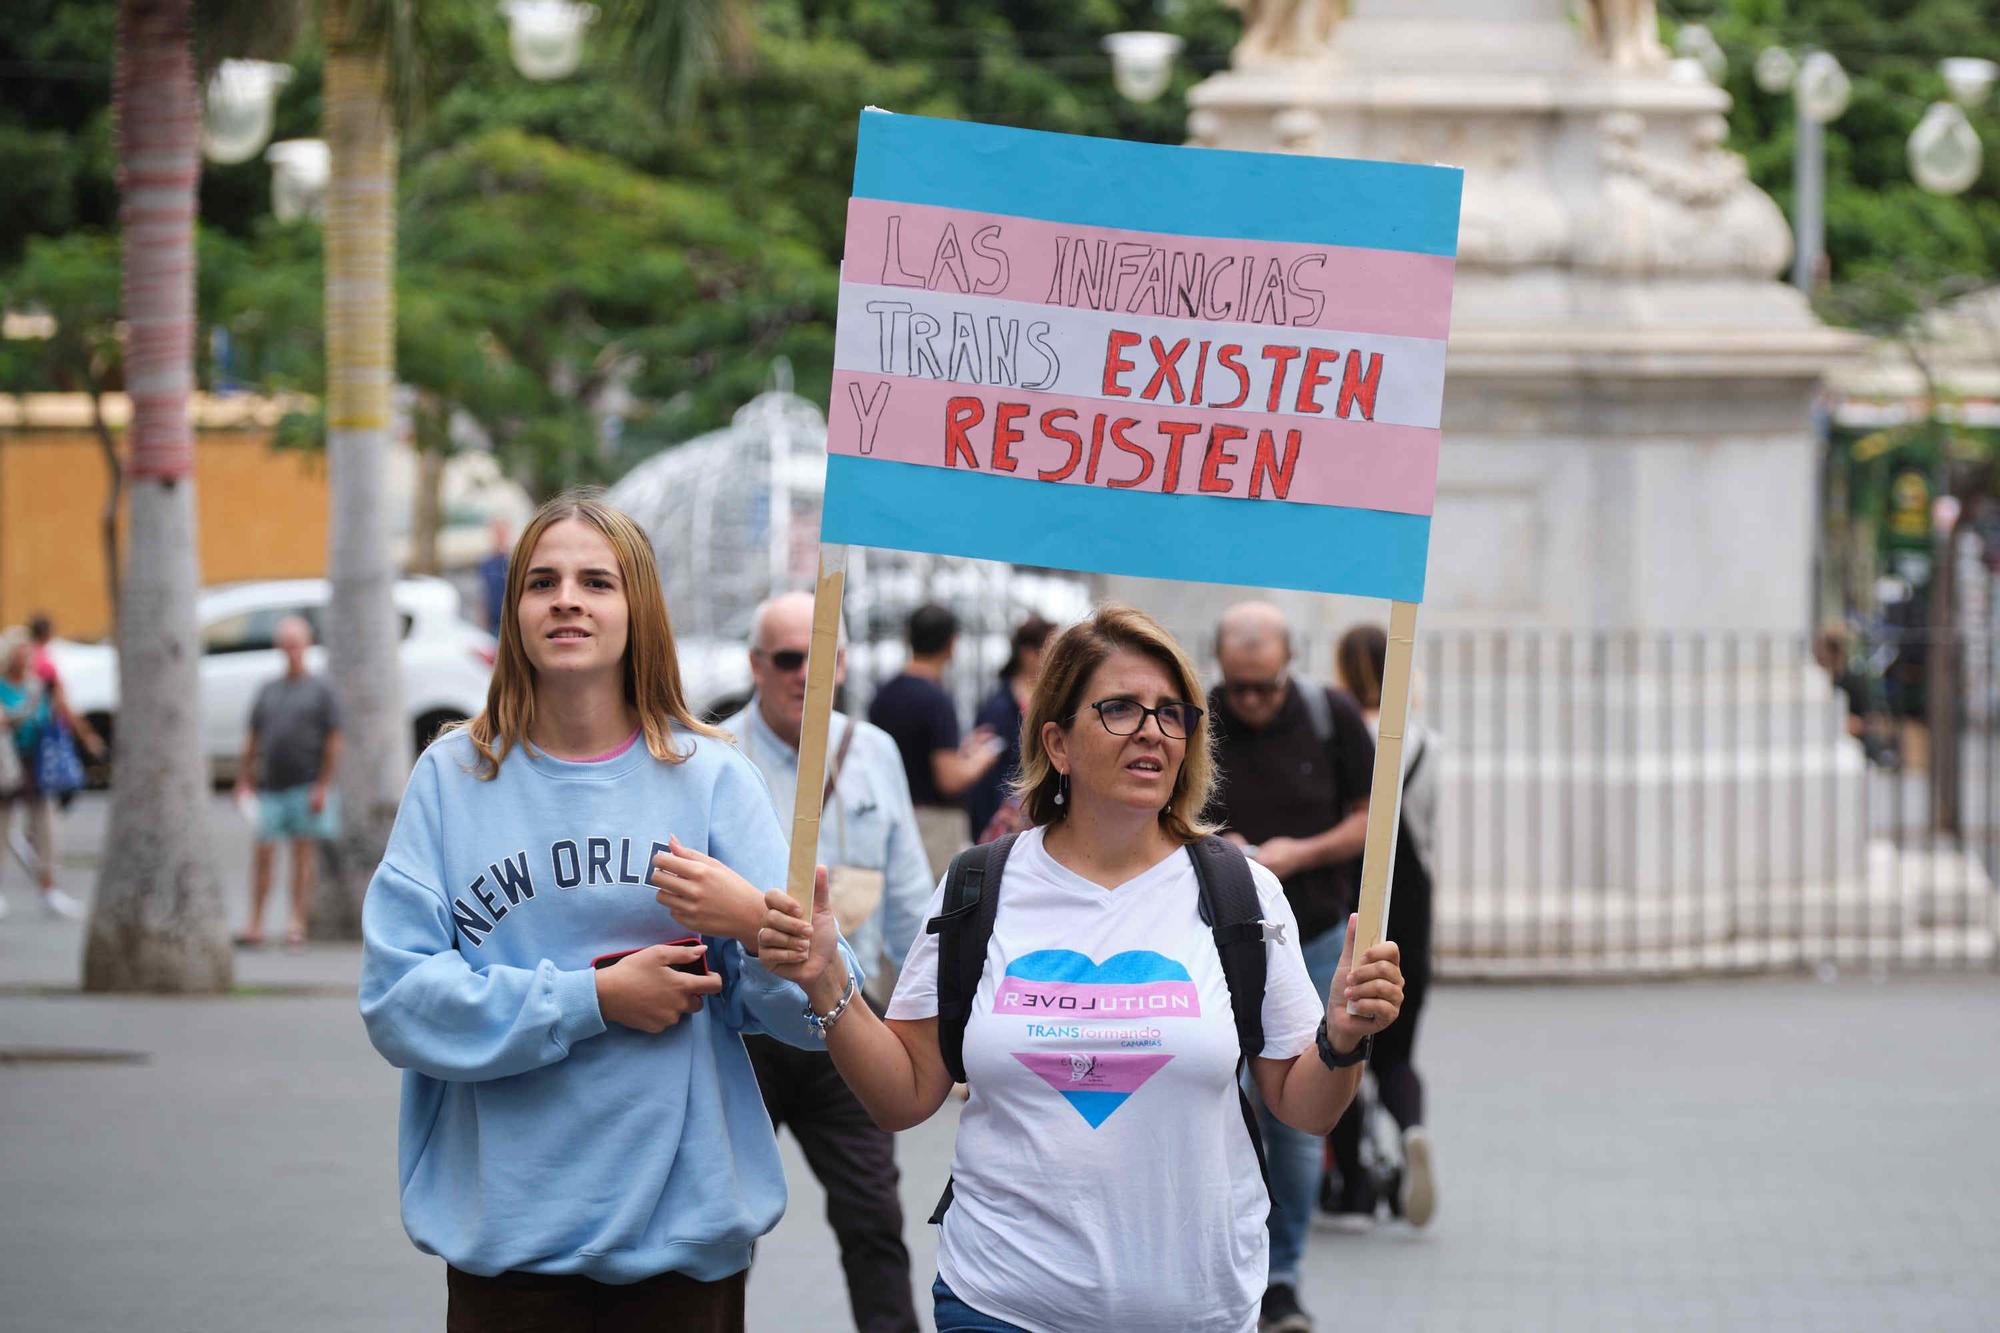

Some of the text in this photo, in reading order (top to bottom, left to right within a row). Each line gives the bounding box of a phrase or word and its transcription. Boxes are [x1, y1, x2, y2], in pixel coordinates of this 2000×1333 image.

[882, 215, 1327, 326] LAS INFANCIAS
[866, 301, 1384, 421] TRANS EXISTEN
[848, 381, 1301, 500] Y RESISTEN
[452, 850, 536, 949] NEW
[1026, 1023, 1161, 1040] TRANSformando
